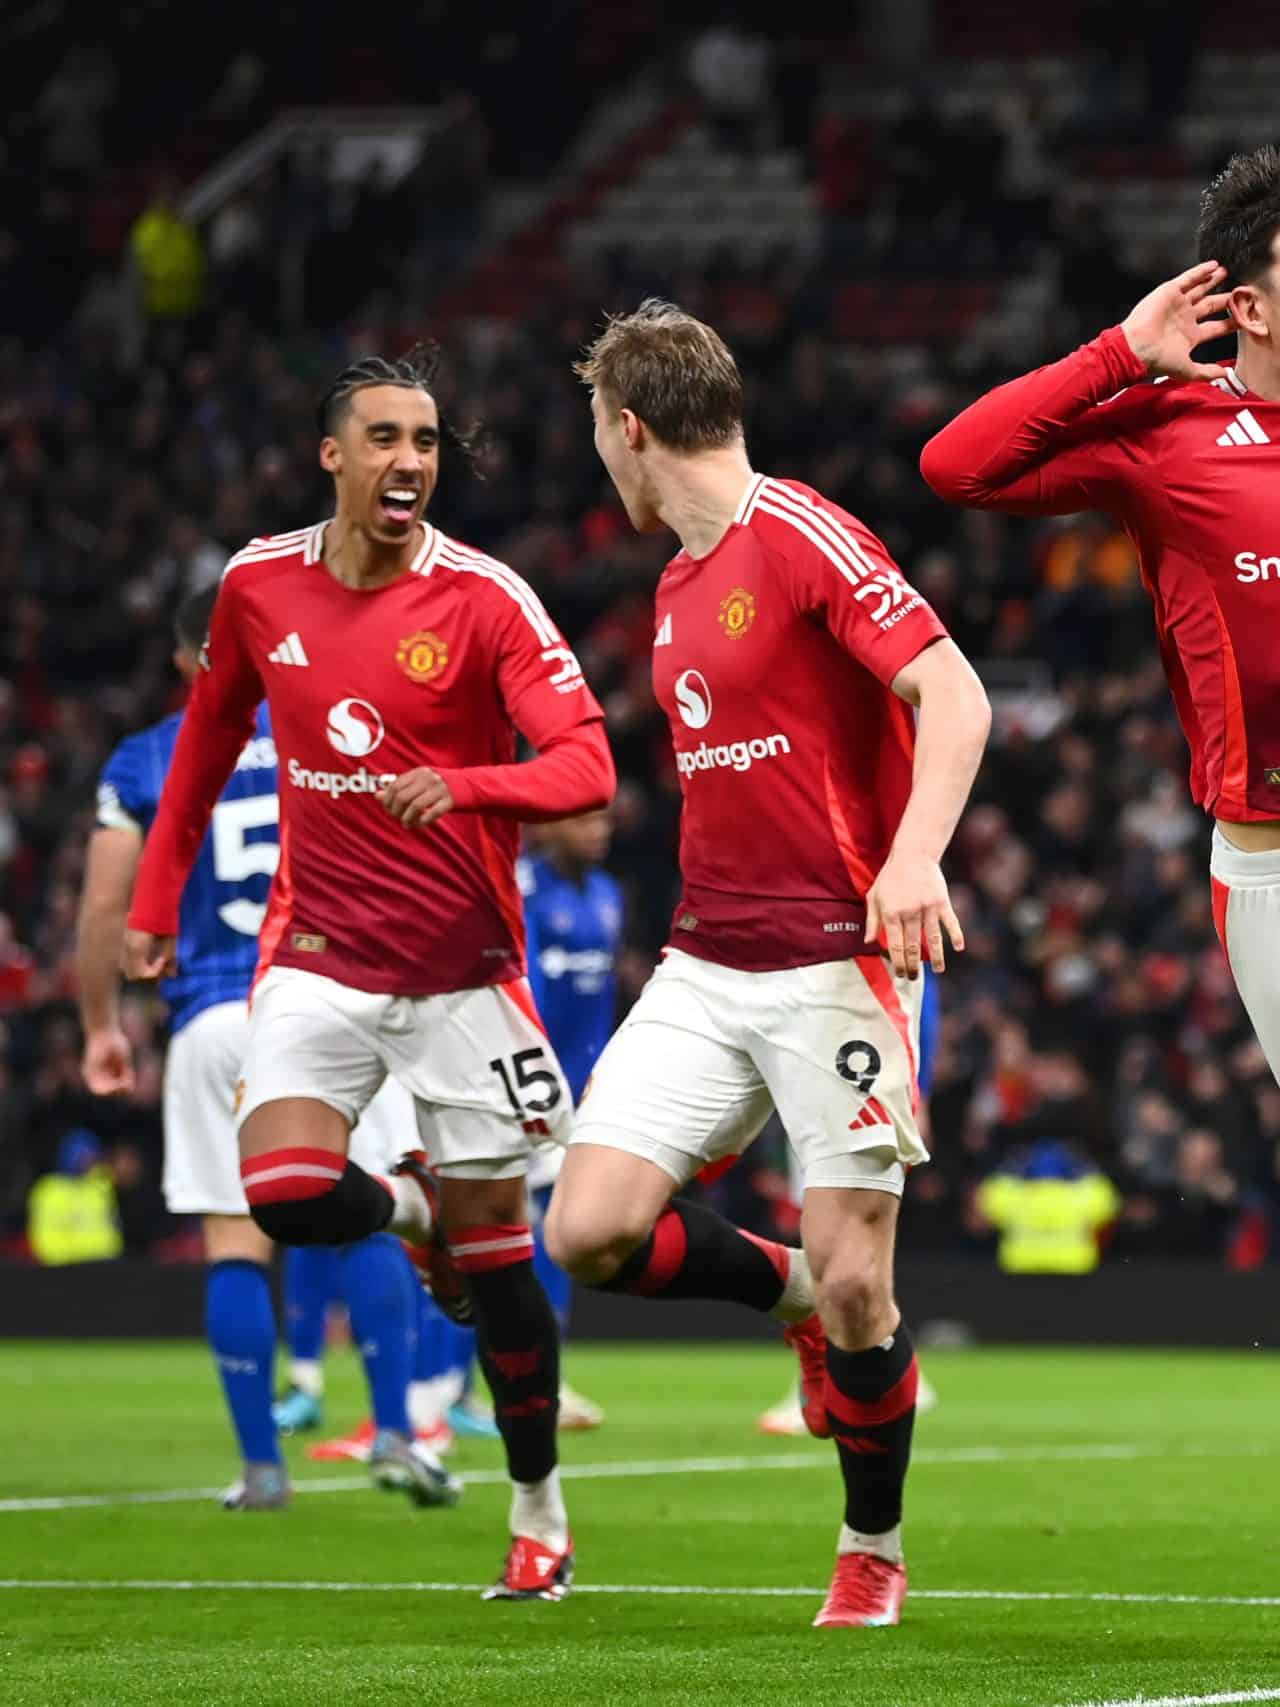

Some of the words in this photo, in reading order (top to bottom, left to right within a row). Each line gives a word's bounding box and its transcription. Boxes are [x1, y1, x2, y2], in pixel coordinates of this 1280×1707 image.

[879, 597, 929, 631] TECHNO
[287, 758, 397, 799] Snapdr
[676, 734, 791, 780] apdragon
[213, 793, 281, 936] 5
[489, 1047, 561, 1120] 15
[835, 1039, 881, 1094] 9
